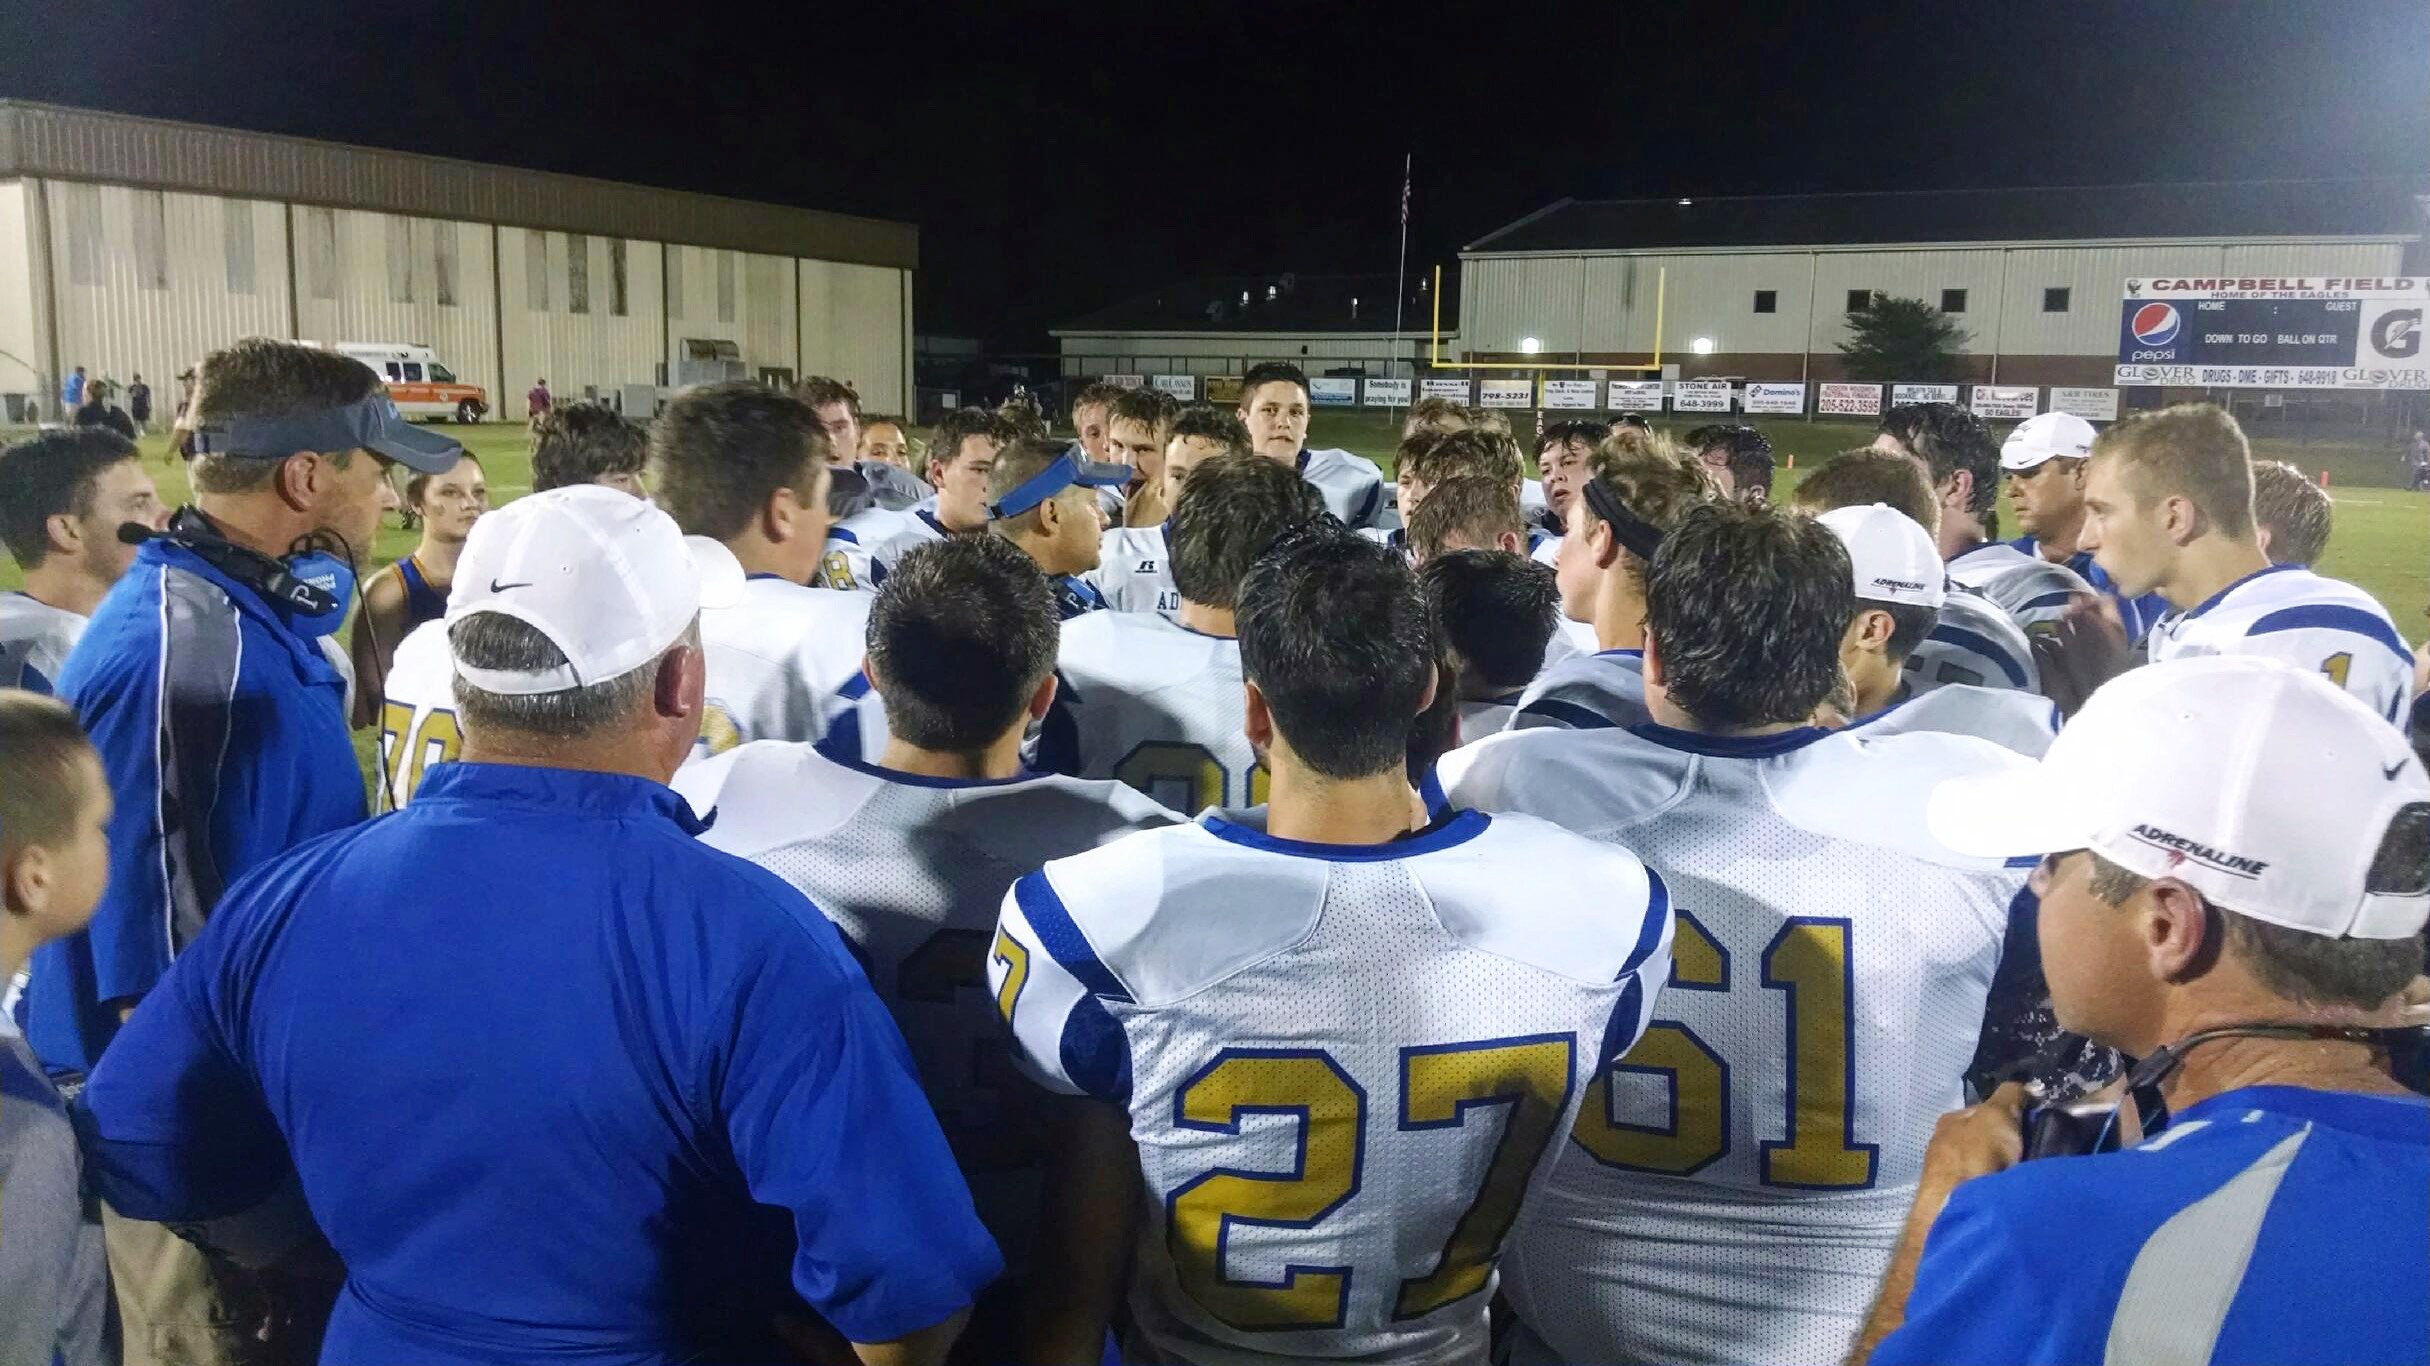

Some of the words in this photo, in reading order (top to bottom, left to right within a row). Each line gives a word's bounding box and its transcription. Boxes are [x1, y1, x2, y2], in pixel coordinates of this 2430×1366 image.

[2152, 279, 2314, 291] CAMPBELL
[2325, 278, 2415, 291] FIELD
[2211, 291, 2247, 299] HOME
[2251, 291, 2267, 299] OF
[2272, 291, 2297, 299] THE
[2300, 291, 2350, 299] EAGLES
[2198, 301, 2226, 311] HOME
[2325, 301, 2357, 312] GUEST
[2205, 334, 2234, 344] DOWN
[2238, 334, 2250, 344] TO
[2252, 334, 2268, 344] GO
[2277, 334, 2301, 345] BALL
[2302, 334, 2316, 344] ON
[2318, 334, 2338, 344] QTR
[2131, 348, 2176, 362] pepsi
[2117, 366, 2195, 381] GLOVER
[2202, 369, 2232, 383] DRUGS
[2239, 369, 2257, 383] DME
[2264, 369, 2289, 384] GIFTS
[1763, 388, 1801, 397] Domino's
[1680, 399, 1724, 408] 648-3999
[2132, 824, 2270, 875] ADRENALINE
[1570, 909, 1879, 1192] 61
[1165, 1031, 1577, 1333] 27
